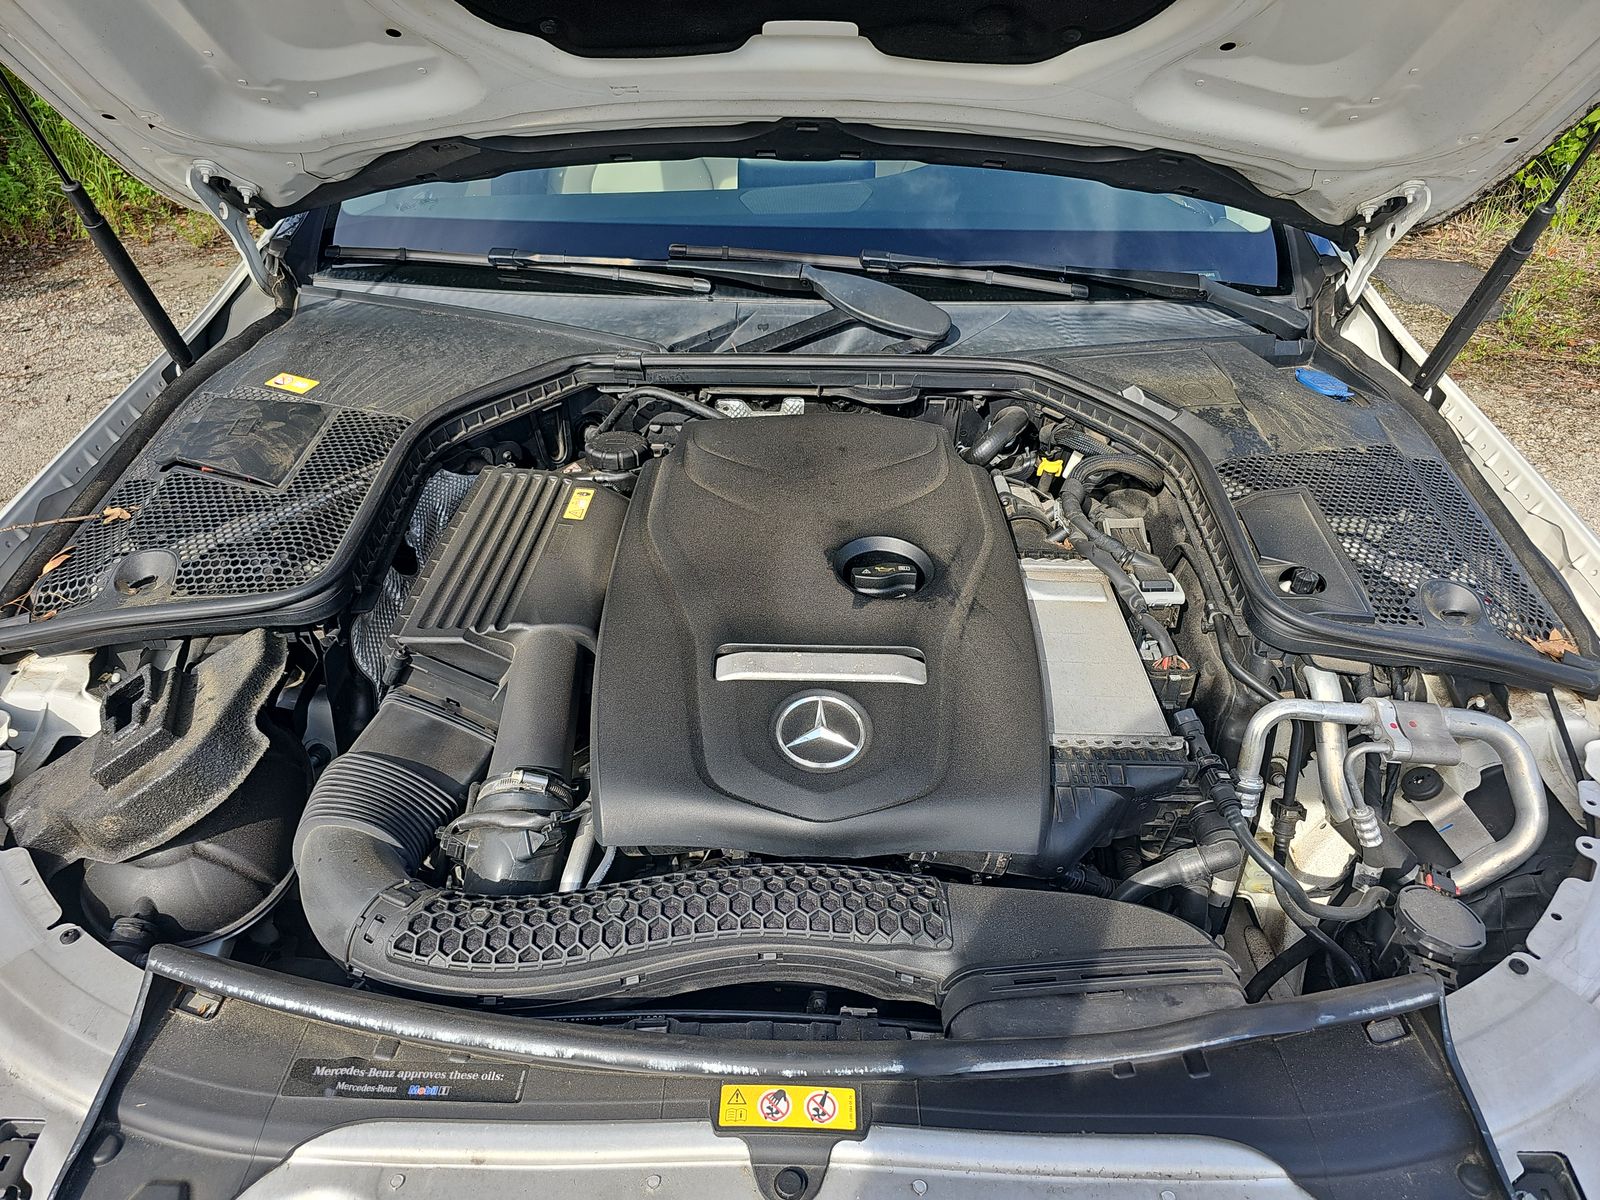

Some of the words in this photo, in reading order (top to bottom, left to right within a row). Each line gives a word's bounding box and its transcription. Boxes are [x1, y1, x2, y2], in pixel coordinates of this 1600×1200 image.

[312, 1066, 396, 1078] Mercedes-Benz
[397, 1070, 446, 1080] approves
[449, 1070, 479, 1080] these
[481, 1071, 505, 1081] oils:
[335, 1081, 398, 1093] Mercedes-Benz
[407, 1085, 439, 1096] Mobil
